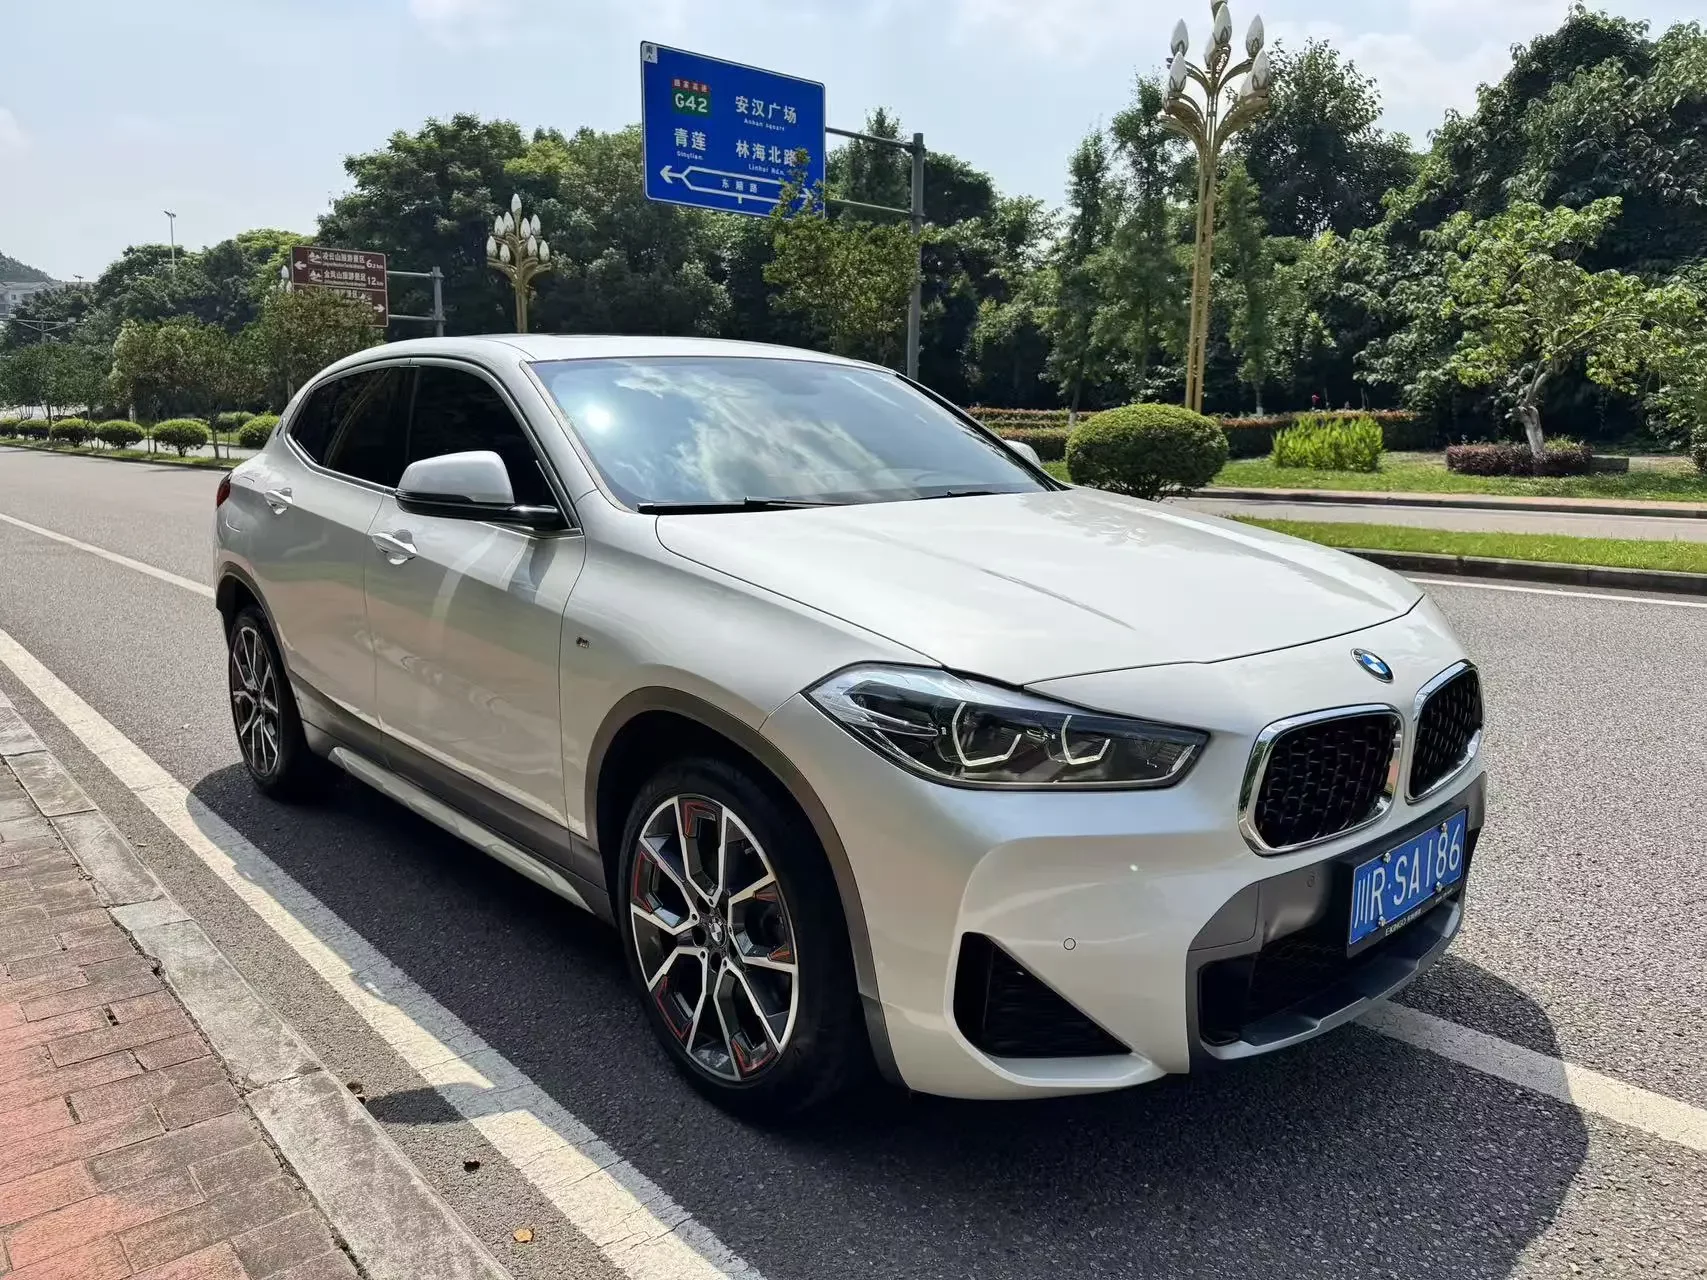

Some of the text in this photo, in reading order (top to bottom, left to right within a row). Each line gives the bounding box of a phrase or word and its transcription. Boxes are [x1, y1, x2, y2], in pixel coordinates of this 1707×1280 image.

[674, 93, 708, 113] G42
[735, 95, 797, 124] 安汉广场
[674, 128, 707, 151] 青莲
[735, 139, 799, 167] 林海北路
